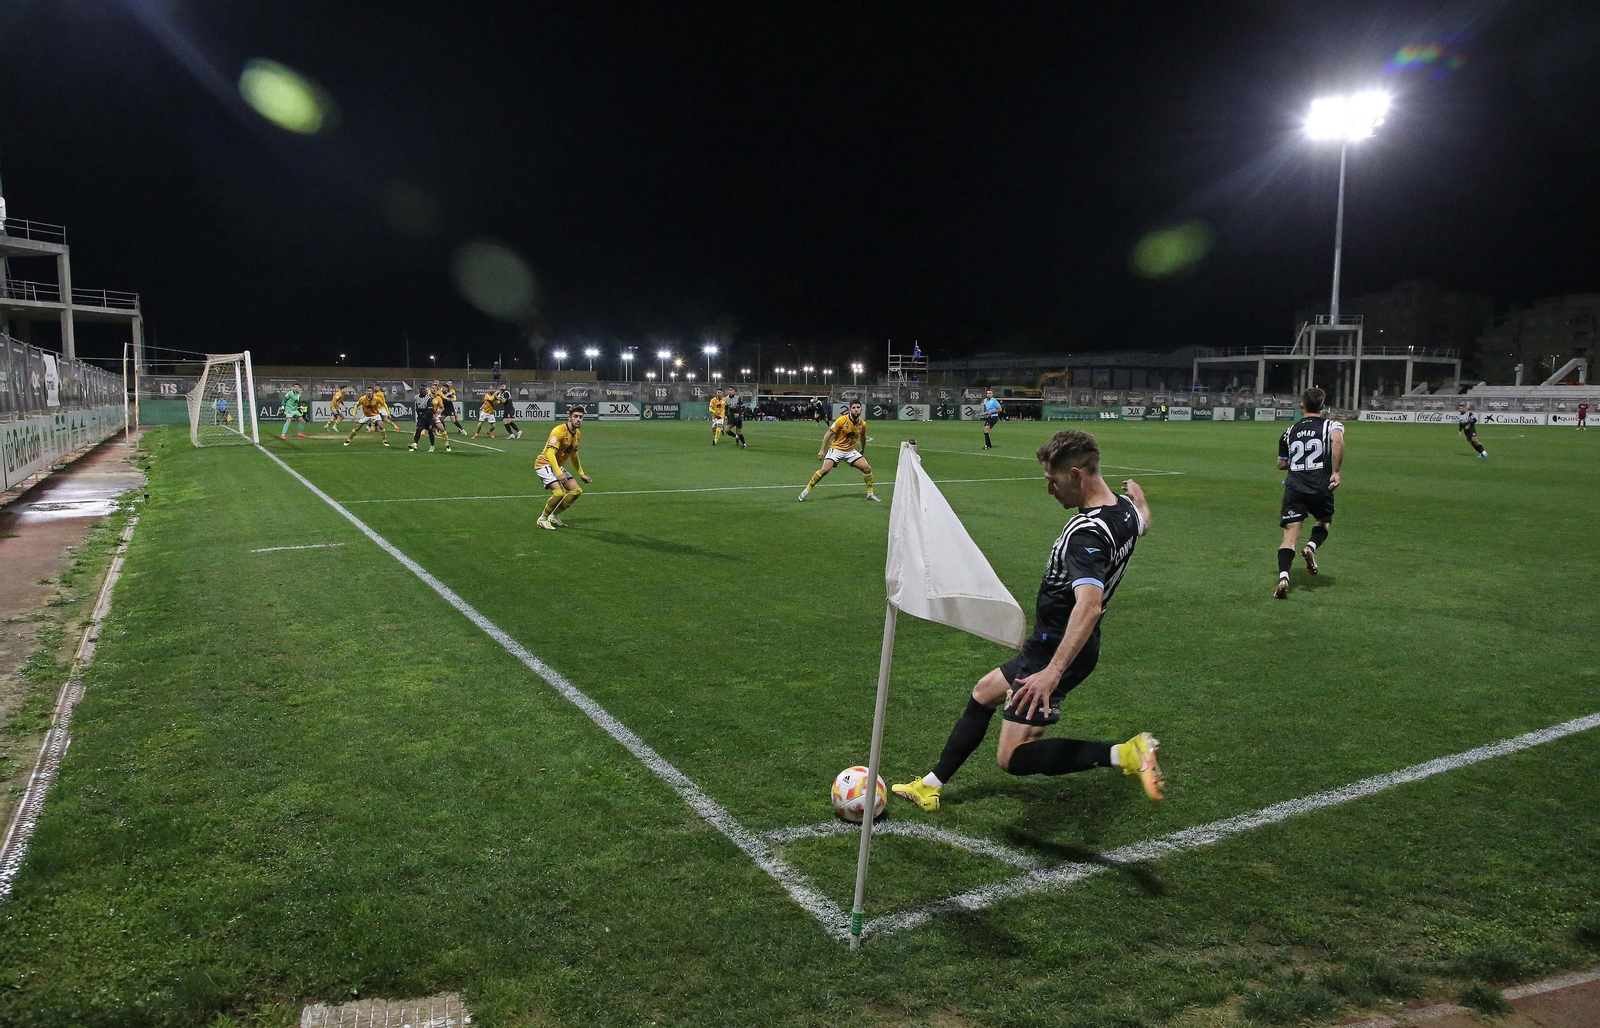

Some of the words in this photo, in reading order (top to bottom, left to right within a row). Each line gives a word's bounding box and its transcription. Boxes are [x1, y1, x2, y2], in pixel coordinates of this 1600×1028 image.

[609, 404, 630, 414] DUX
[1496, 415, 1539, 424] CaixaBank
[1296, 430, 1316, 438] OMAR
[1290, 438, 1324, 472] 22
